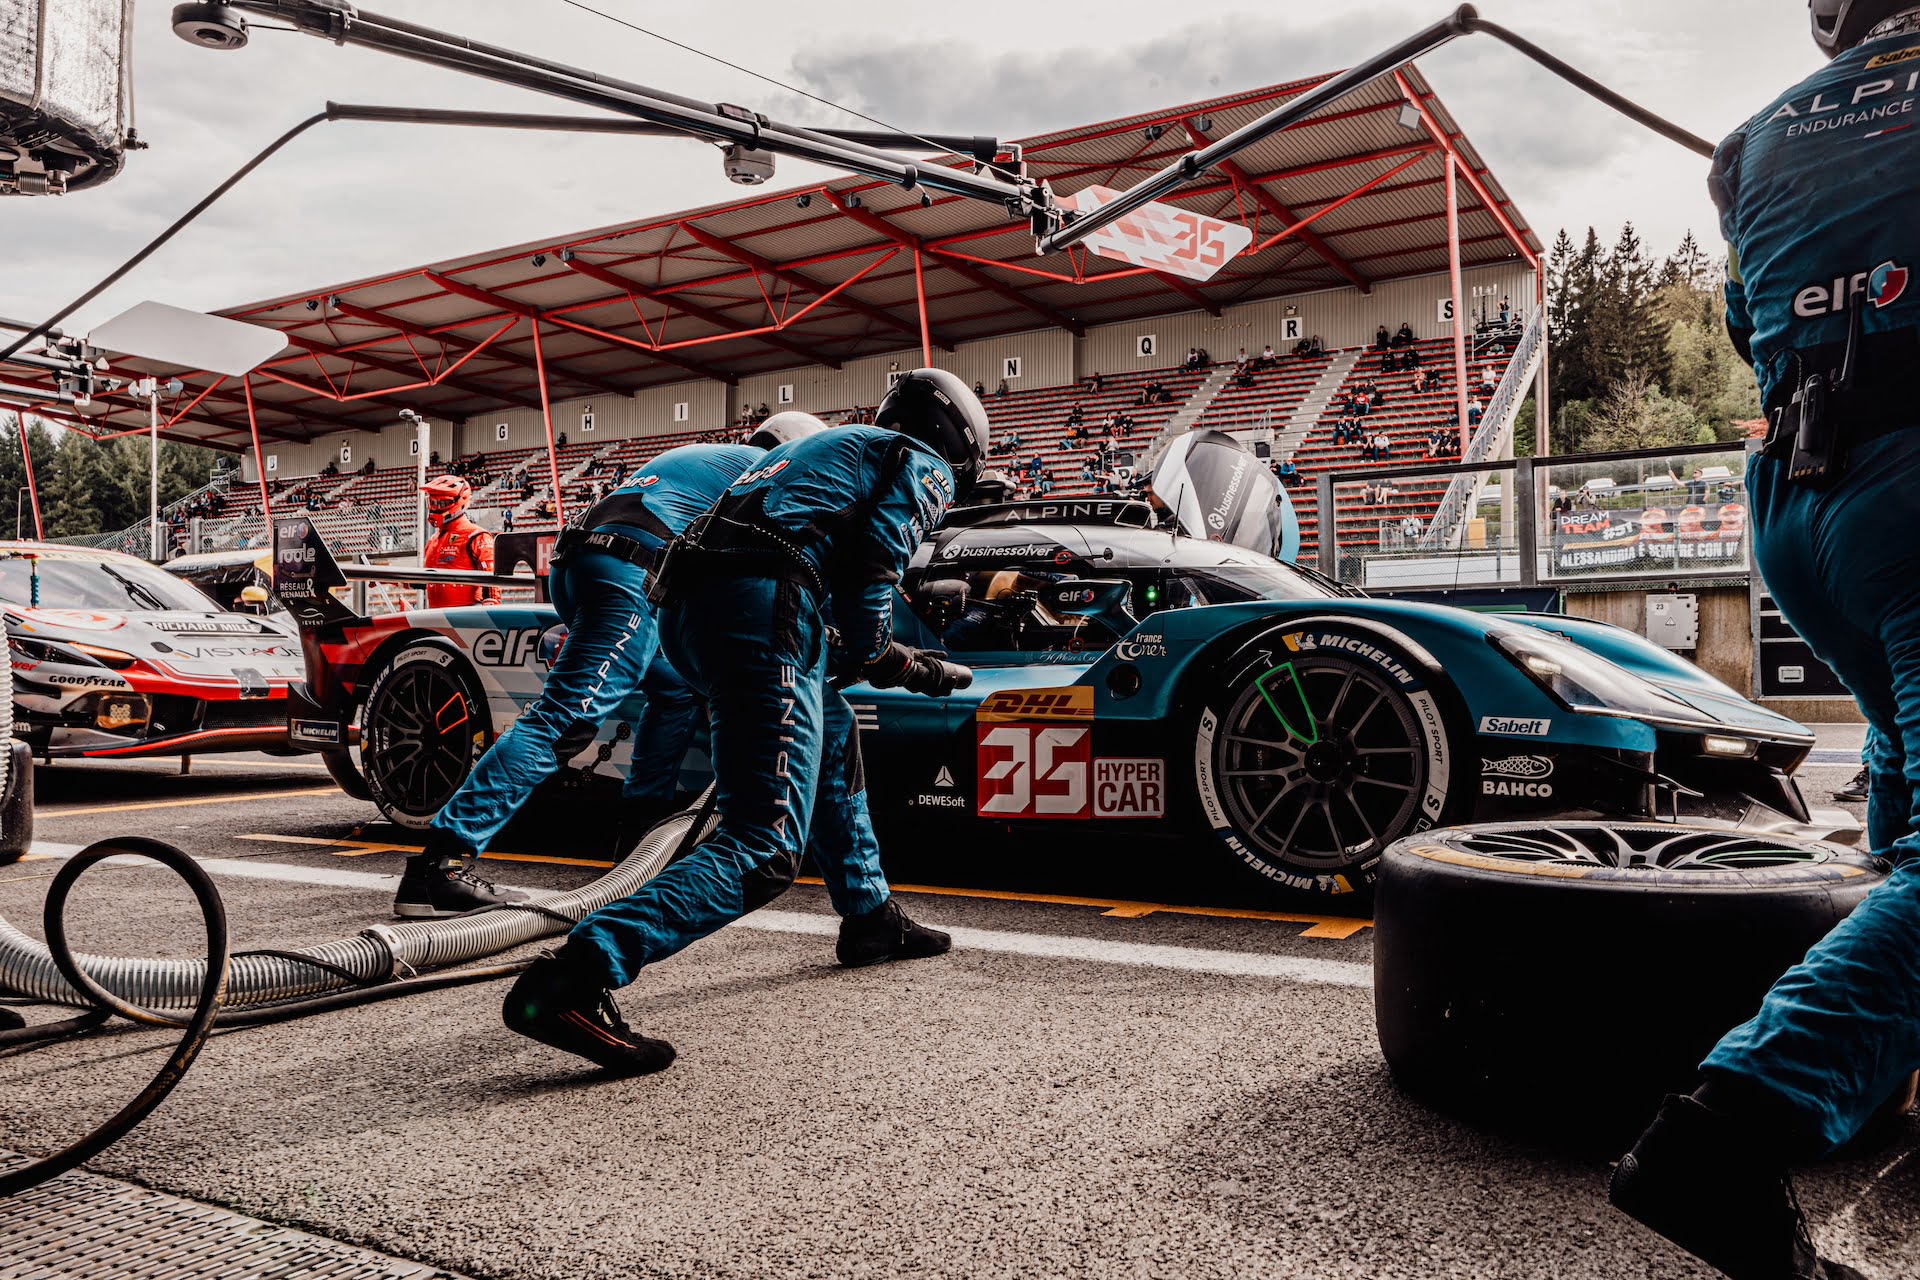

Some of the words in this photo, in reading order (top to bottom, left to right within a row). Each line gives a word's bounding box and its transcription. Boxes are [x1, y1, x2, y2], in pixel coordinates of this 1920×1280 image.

[1786, 98, 1915, 137] ENDURANCE
[1171, 212, 1227, 268] 35
[1793, 271, 1868, 318] elf
[1286, 319, 1298, 338] R
[1141, 337, 1152, 355] Q
[1007, 359, 1017, 376] N
[782, 387, 790, 402] L
[584, 415, 592, 430] H
[499, 425, 506, 439] G
[342, 448, 349, 461] C
[412, 440, 419, 454] D
[932, 469, 951, 495] elf
[1213, 455, 1249, 517] businessolver
[1004, 503, 1113, 521] ALPINE
[1561, 511, 1610, 525] DREAM
[280, 524, 298, 539] elf
[1562, 519, 1610, 535] TEAM
[961, 544, 1054, 557] businessolver
[1560, 548, 1636, 567] ALESSANDRIA
[1697, 542, 1722, 557] CON
[280, 590, 310, 599] RENAULT
[1058, 590, 1081, 602] elf
[152, 622, 218, 632] RICHARD
[221, 622, 258, 632] MILLE
[474, 628, 540, 666] elf
[1135, 633, 1163, 643] France
[175, 645, 305, 658] VISTAJE
[439, 654, 449, 665] S
[1319, 634, 1415, 685] MICHELIN
[581, 612, 642, 714] ALPINE
[48, 675, 126, 688] GOODYEAR
[362, 664, 391, 727] MICHELIN
[991, 693, 1078, 715] DHL
[302, 727, 338, 737] MICHELIN
[1202, 716, 1214, 732] S
[1418, 698, 1436, 728] PILOT
[1430, 728, 1444, 765] SPORT
[1486, 719, 1543, 735] Sabelt
[771, 664, 797, 841] ALPINE
[979, 727, 1089, 814] 35
[1097, 762, 1160, 782] HYPER
[1199, 760, 1211, 793] SPORT
[1097, 782, 1160, 812] CAR
[1482, 780, 1553, 798] BAHCO
[918, 794, 965, 808] DEWESoft
[1204, 793, 1221, 822] PILOT
[1426, 793, 1441, 812] S
[1225, 834, 1314, 891] MICHELIN
